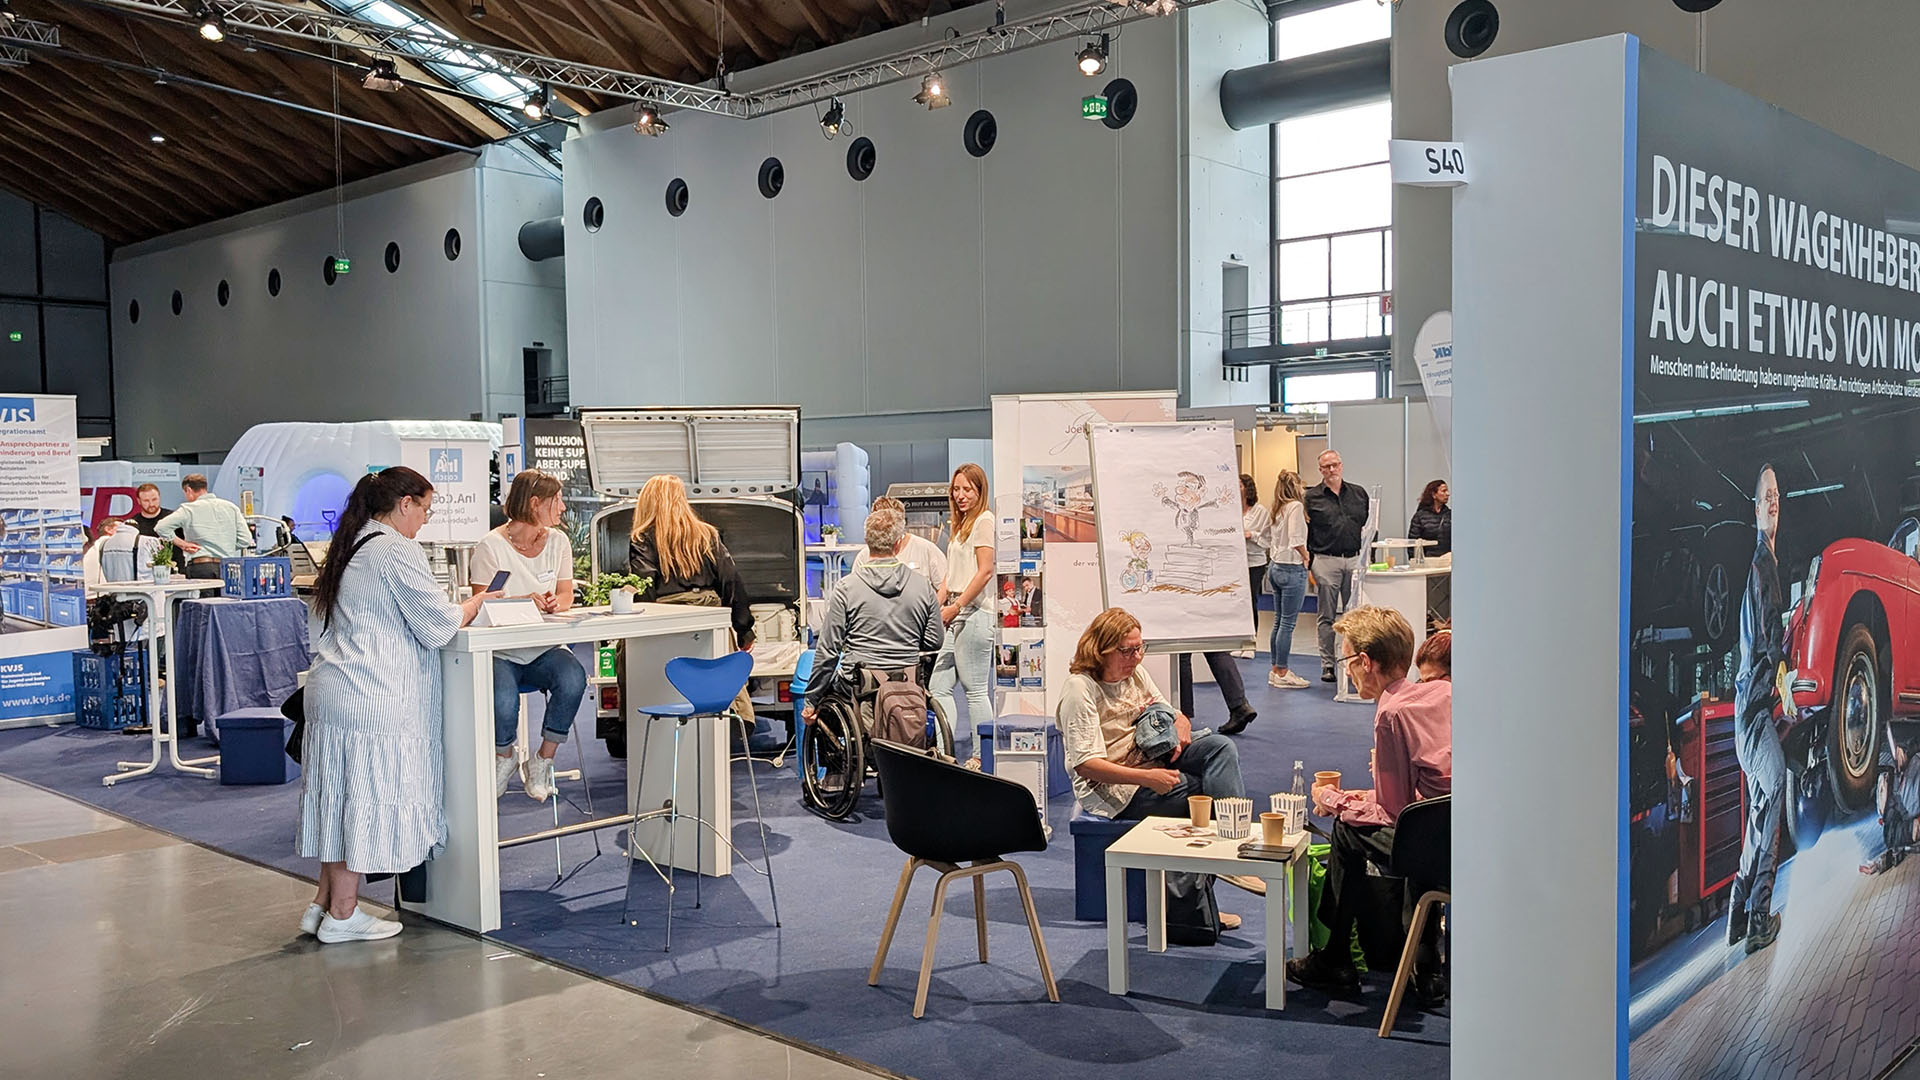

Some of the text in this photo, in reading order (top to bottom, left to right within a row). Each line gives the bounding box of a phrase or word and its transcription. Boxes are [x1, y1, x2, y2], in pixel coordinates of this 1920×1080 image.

[1425, 148, 1464, 175] S40
[1652, 155, 1920, 293] DIESER WAGENHEBER
[1650, 270, 1739, 349] AUCH
[1749, 289, 1836, 362] ETWAS
[1842, 308, 1887, 367] VON
[1650, 354, 1693, 377] Menschen
[1695, 360, 1709, 379] mit
[1710, 361, 1758, 388] Behinderung
[1760, 366, 1782, 386] haben
[1783, 371, 1819, 392] ungeahnte
[1848, 377, 1871, 398] richtigen
[1872, 379, 1903, 399] Arbeitsplatz
[0, 440, 60, 448] Ansprechpartner
[534, 435, 584, 446] INKLUSION
[535, 447, 585, 458] KEINE SUP
[536, 459, 587, 469] ABER SUPE
[0, 664, 24, 673] KVJS
[2, 693, 71, 708] www.kvjs.de
